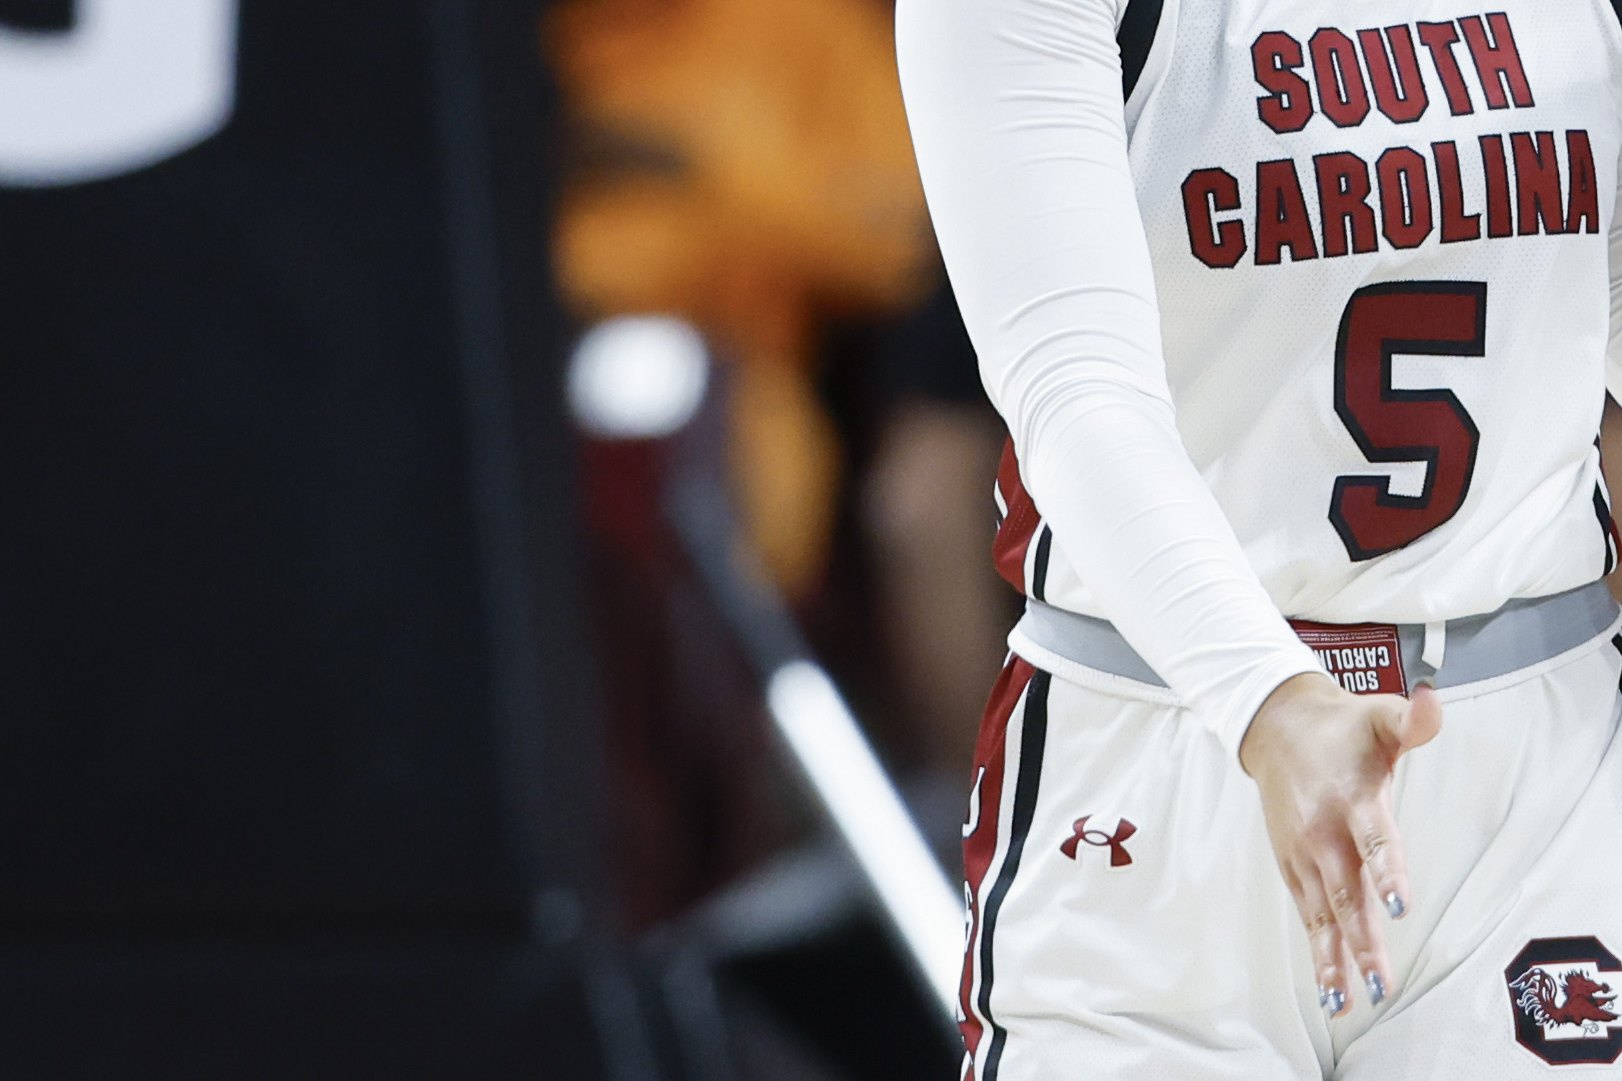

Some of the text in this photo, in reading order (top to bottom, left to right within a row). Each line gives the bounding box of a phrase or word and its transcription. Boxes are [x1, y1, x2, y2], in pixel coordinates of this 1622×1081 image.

[1250, 11, 1536, 135] SOUTH
[1180, 129, 1601, 269] CAROLINA
[1327, 279, 1488, 563] 5
[1334, 670, 1379, 693] SOU
